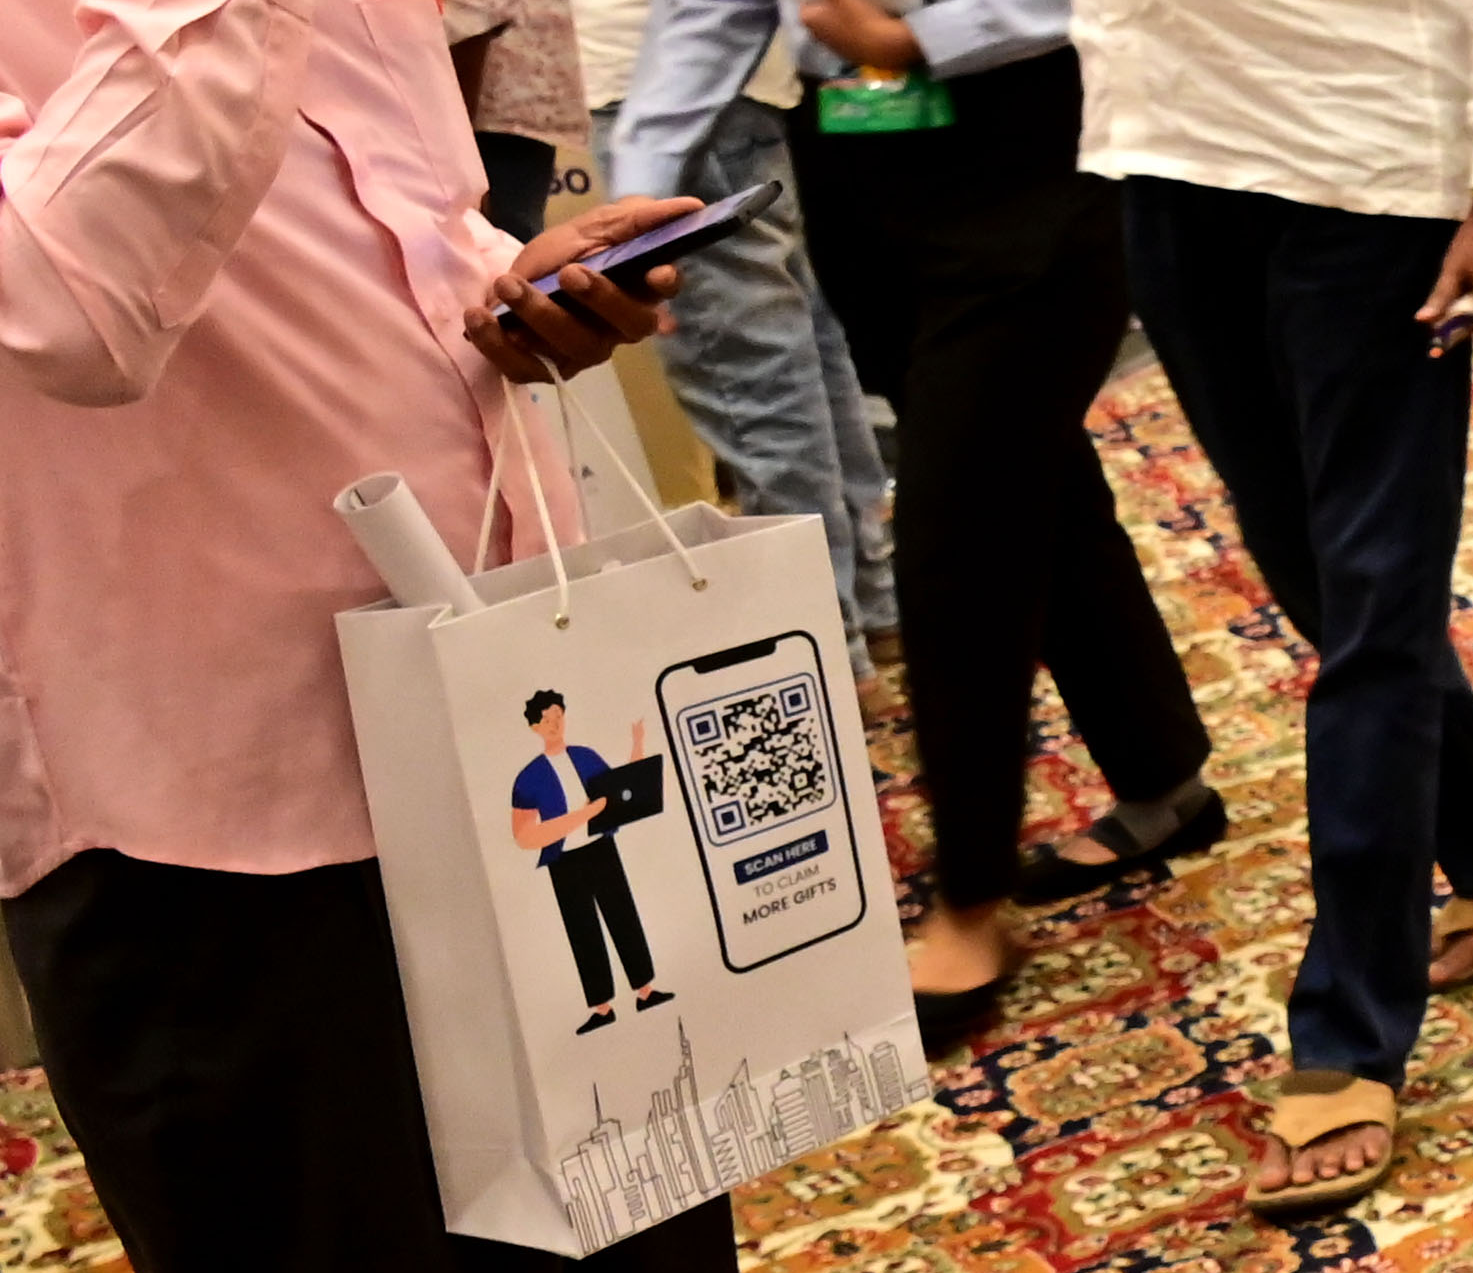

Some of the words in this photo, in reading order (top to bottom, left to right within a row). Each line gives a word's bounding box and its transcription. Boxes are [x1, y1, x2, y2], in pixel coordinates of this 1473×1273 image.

[744, 852, 784, 876] SCAN
[785, 839, 818, 861] HERE
[754, 882, 775, 898] TO
[776, 864, 821, 890] CLAIM
[742, 896, 789, 925] MORE
[793, 877, 837, 905] GIFTS
